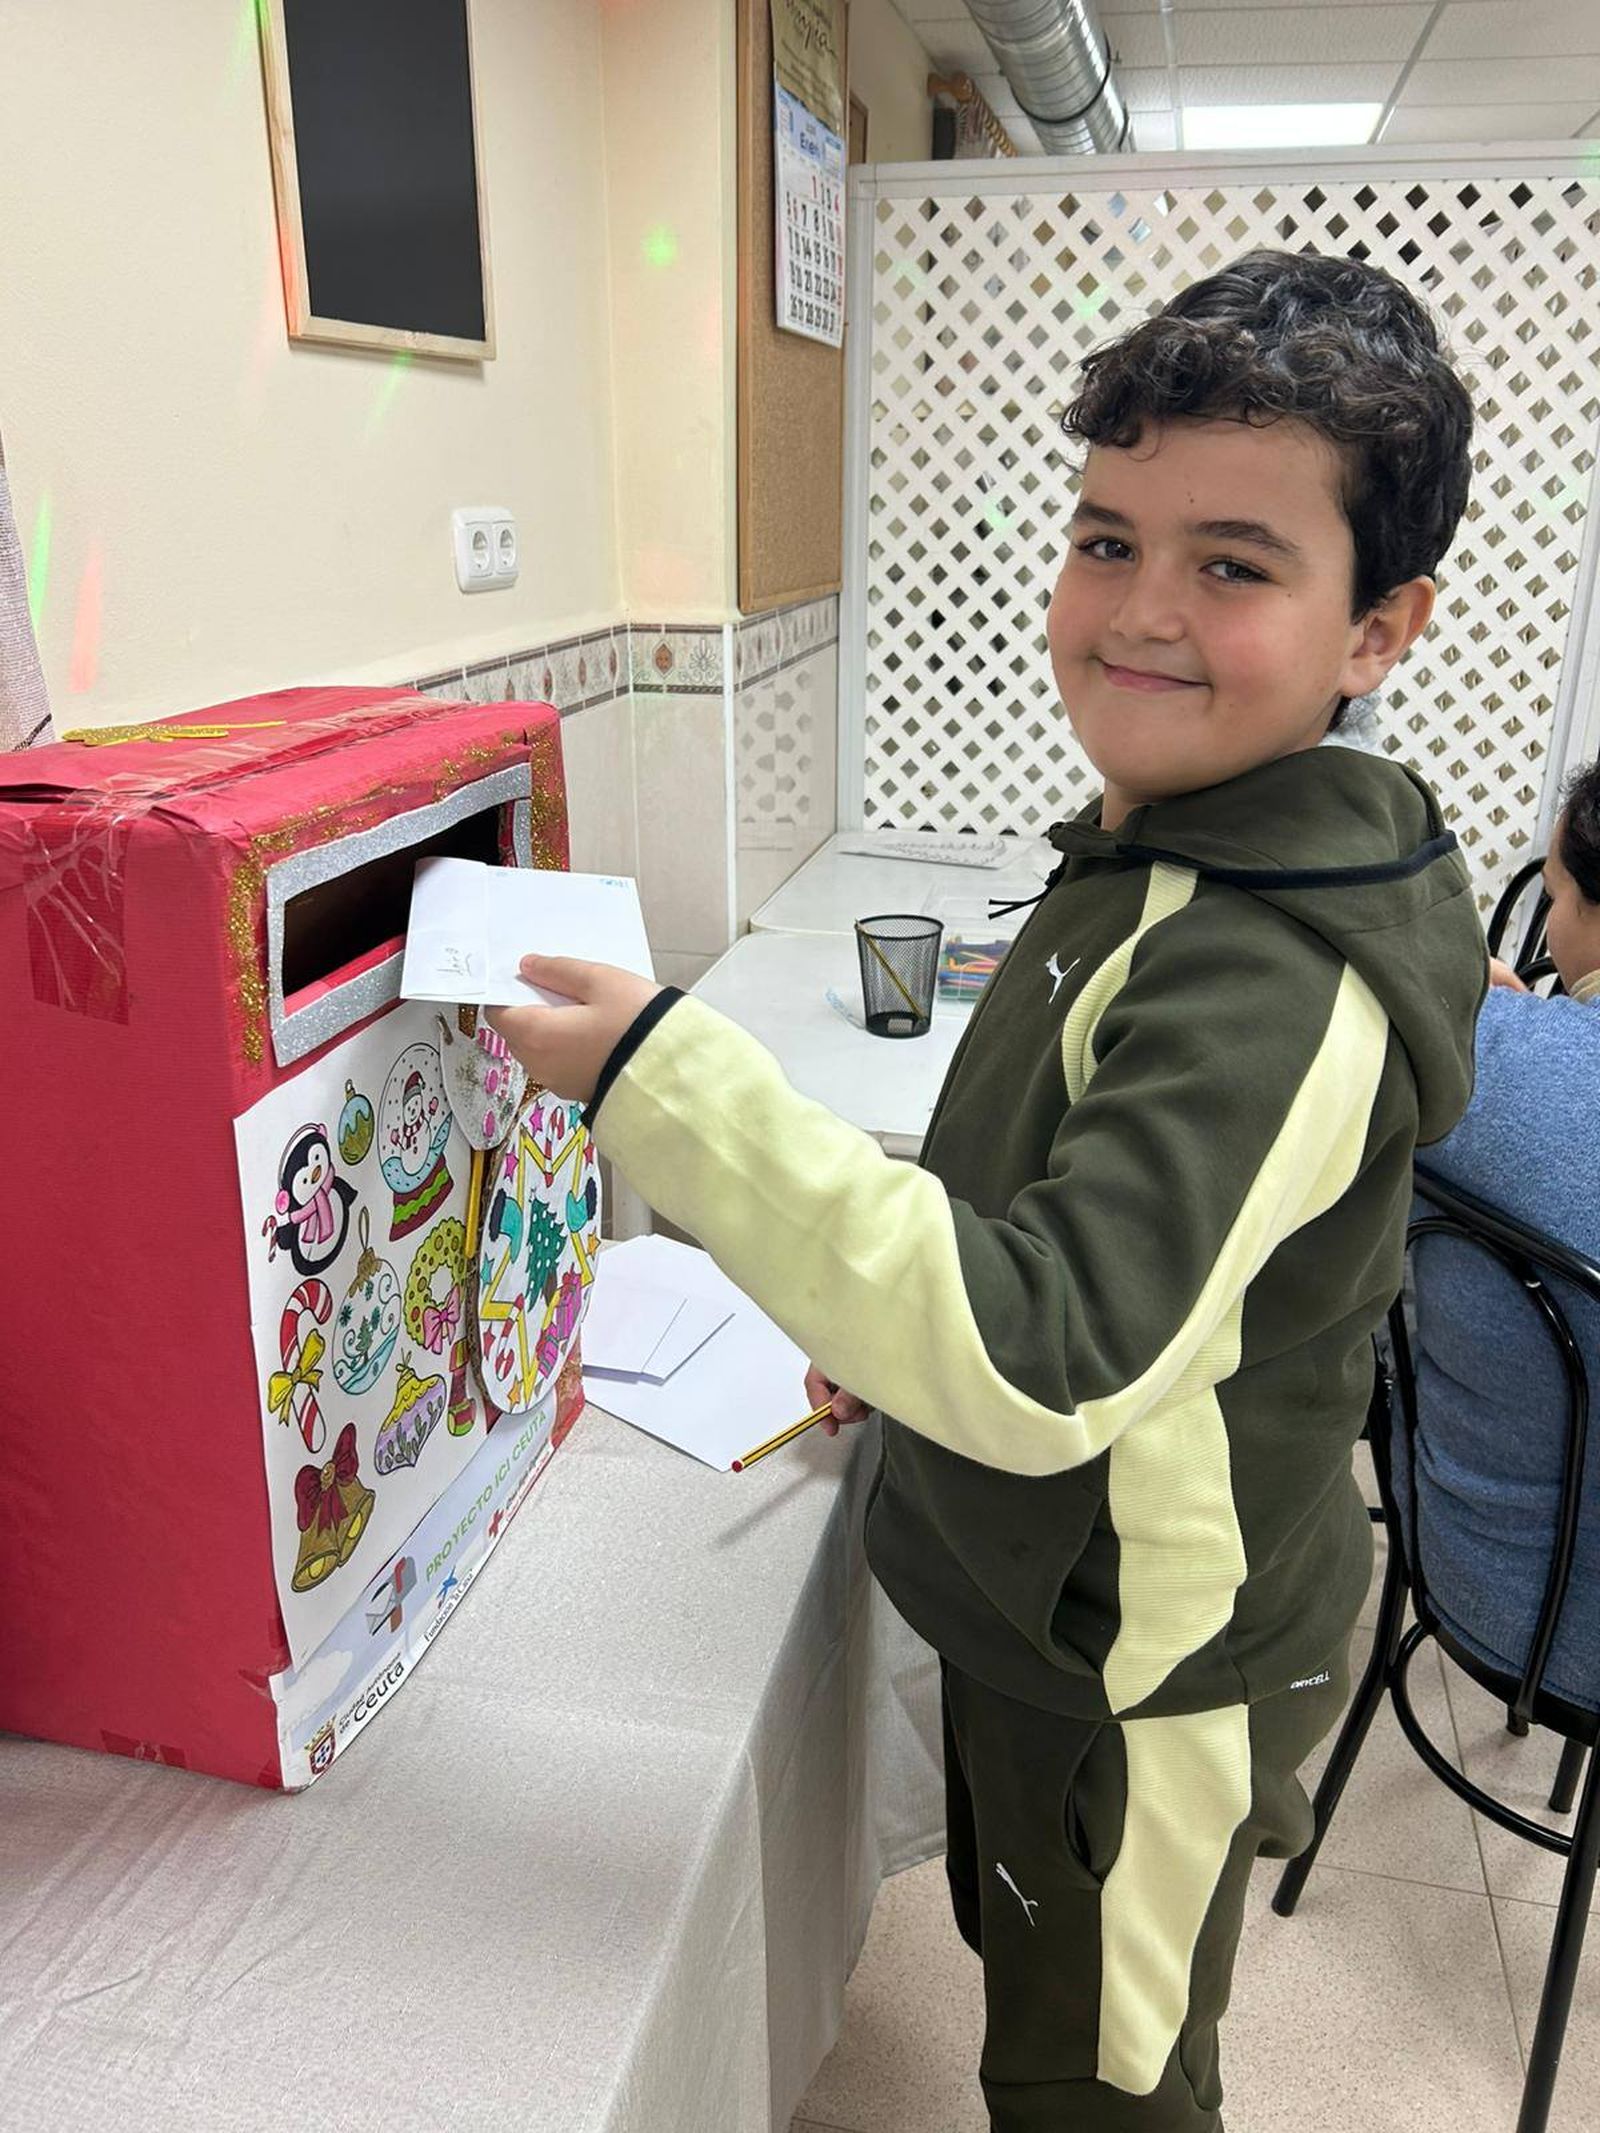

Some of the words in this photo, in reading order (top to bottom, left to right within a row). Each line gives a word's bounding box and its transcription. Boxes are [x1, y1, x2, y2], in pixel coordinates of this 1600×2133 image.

[426, 1486, 492, 1582] PROYECTO
[512, 1410, 547, 1461] CEUTA
[354, 1661, 404, 1722] Ceuta
